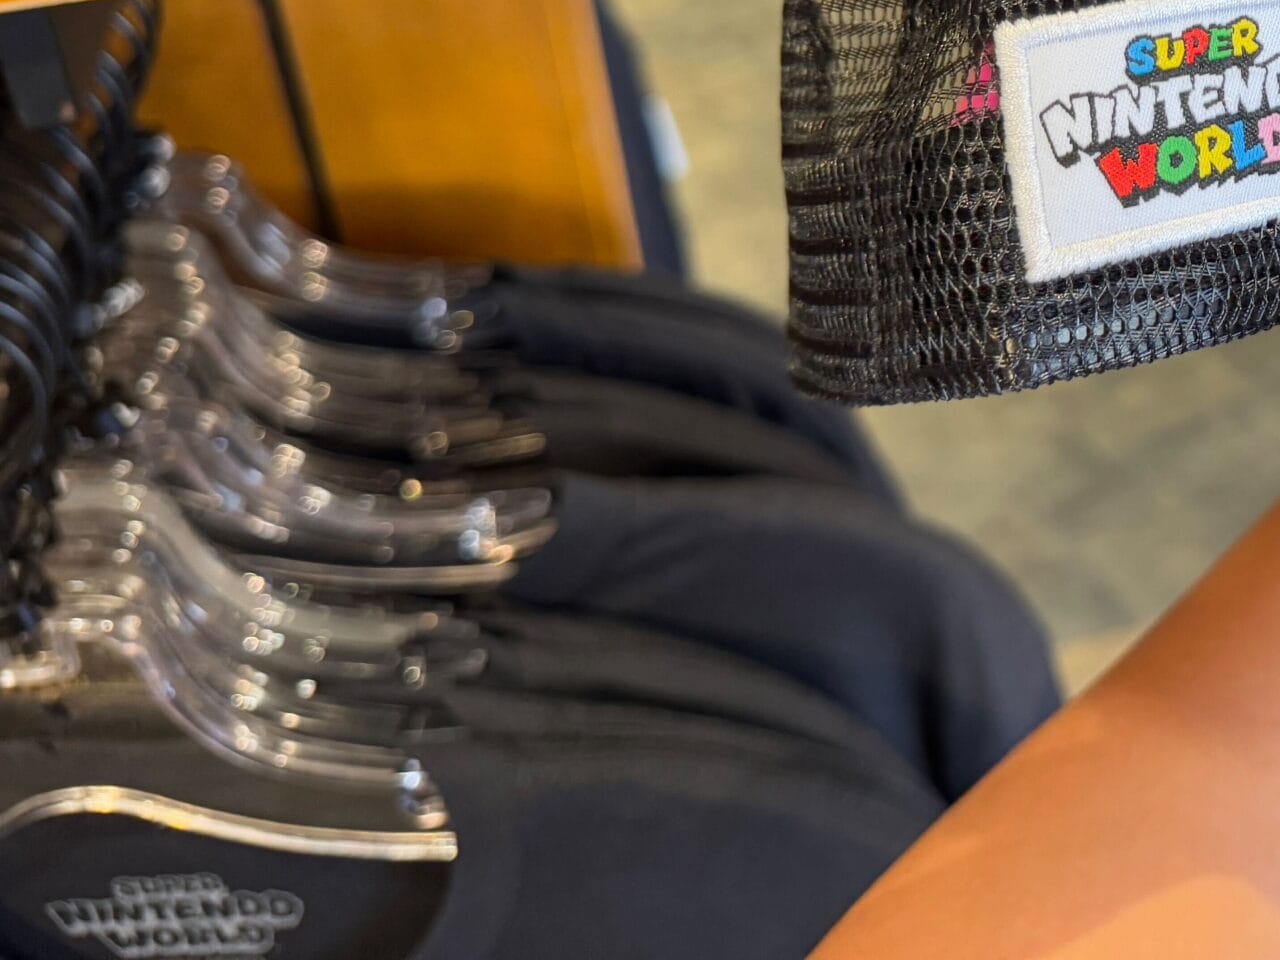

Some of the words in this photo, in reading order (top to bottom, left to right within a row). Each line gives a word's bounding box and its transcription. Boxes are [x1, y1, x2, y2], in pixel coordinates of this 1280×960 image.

[1125, 15, 1263, 83] SUPER
[111, 872, 229, 900] SUPER
[45, 889, 304, 936] NINTENDO
[101, 924, 275, 958] WORLD
